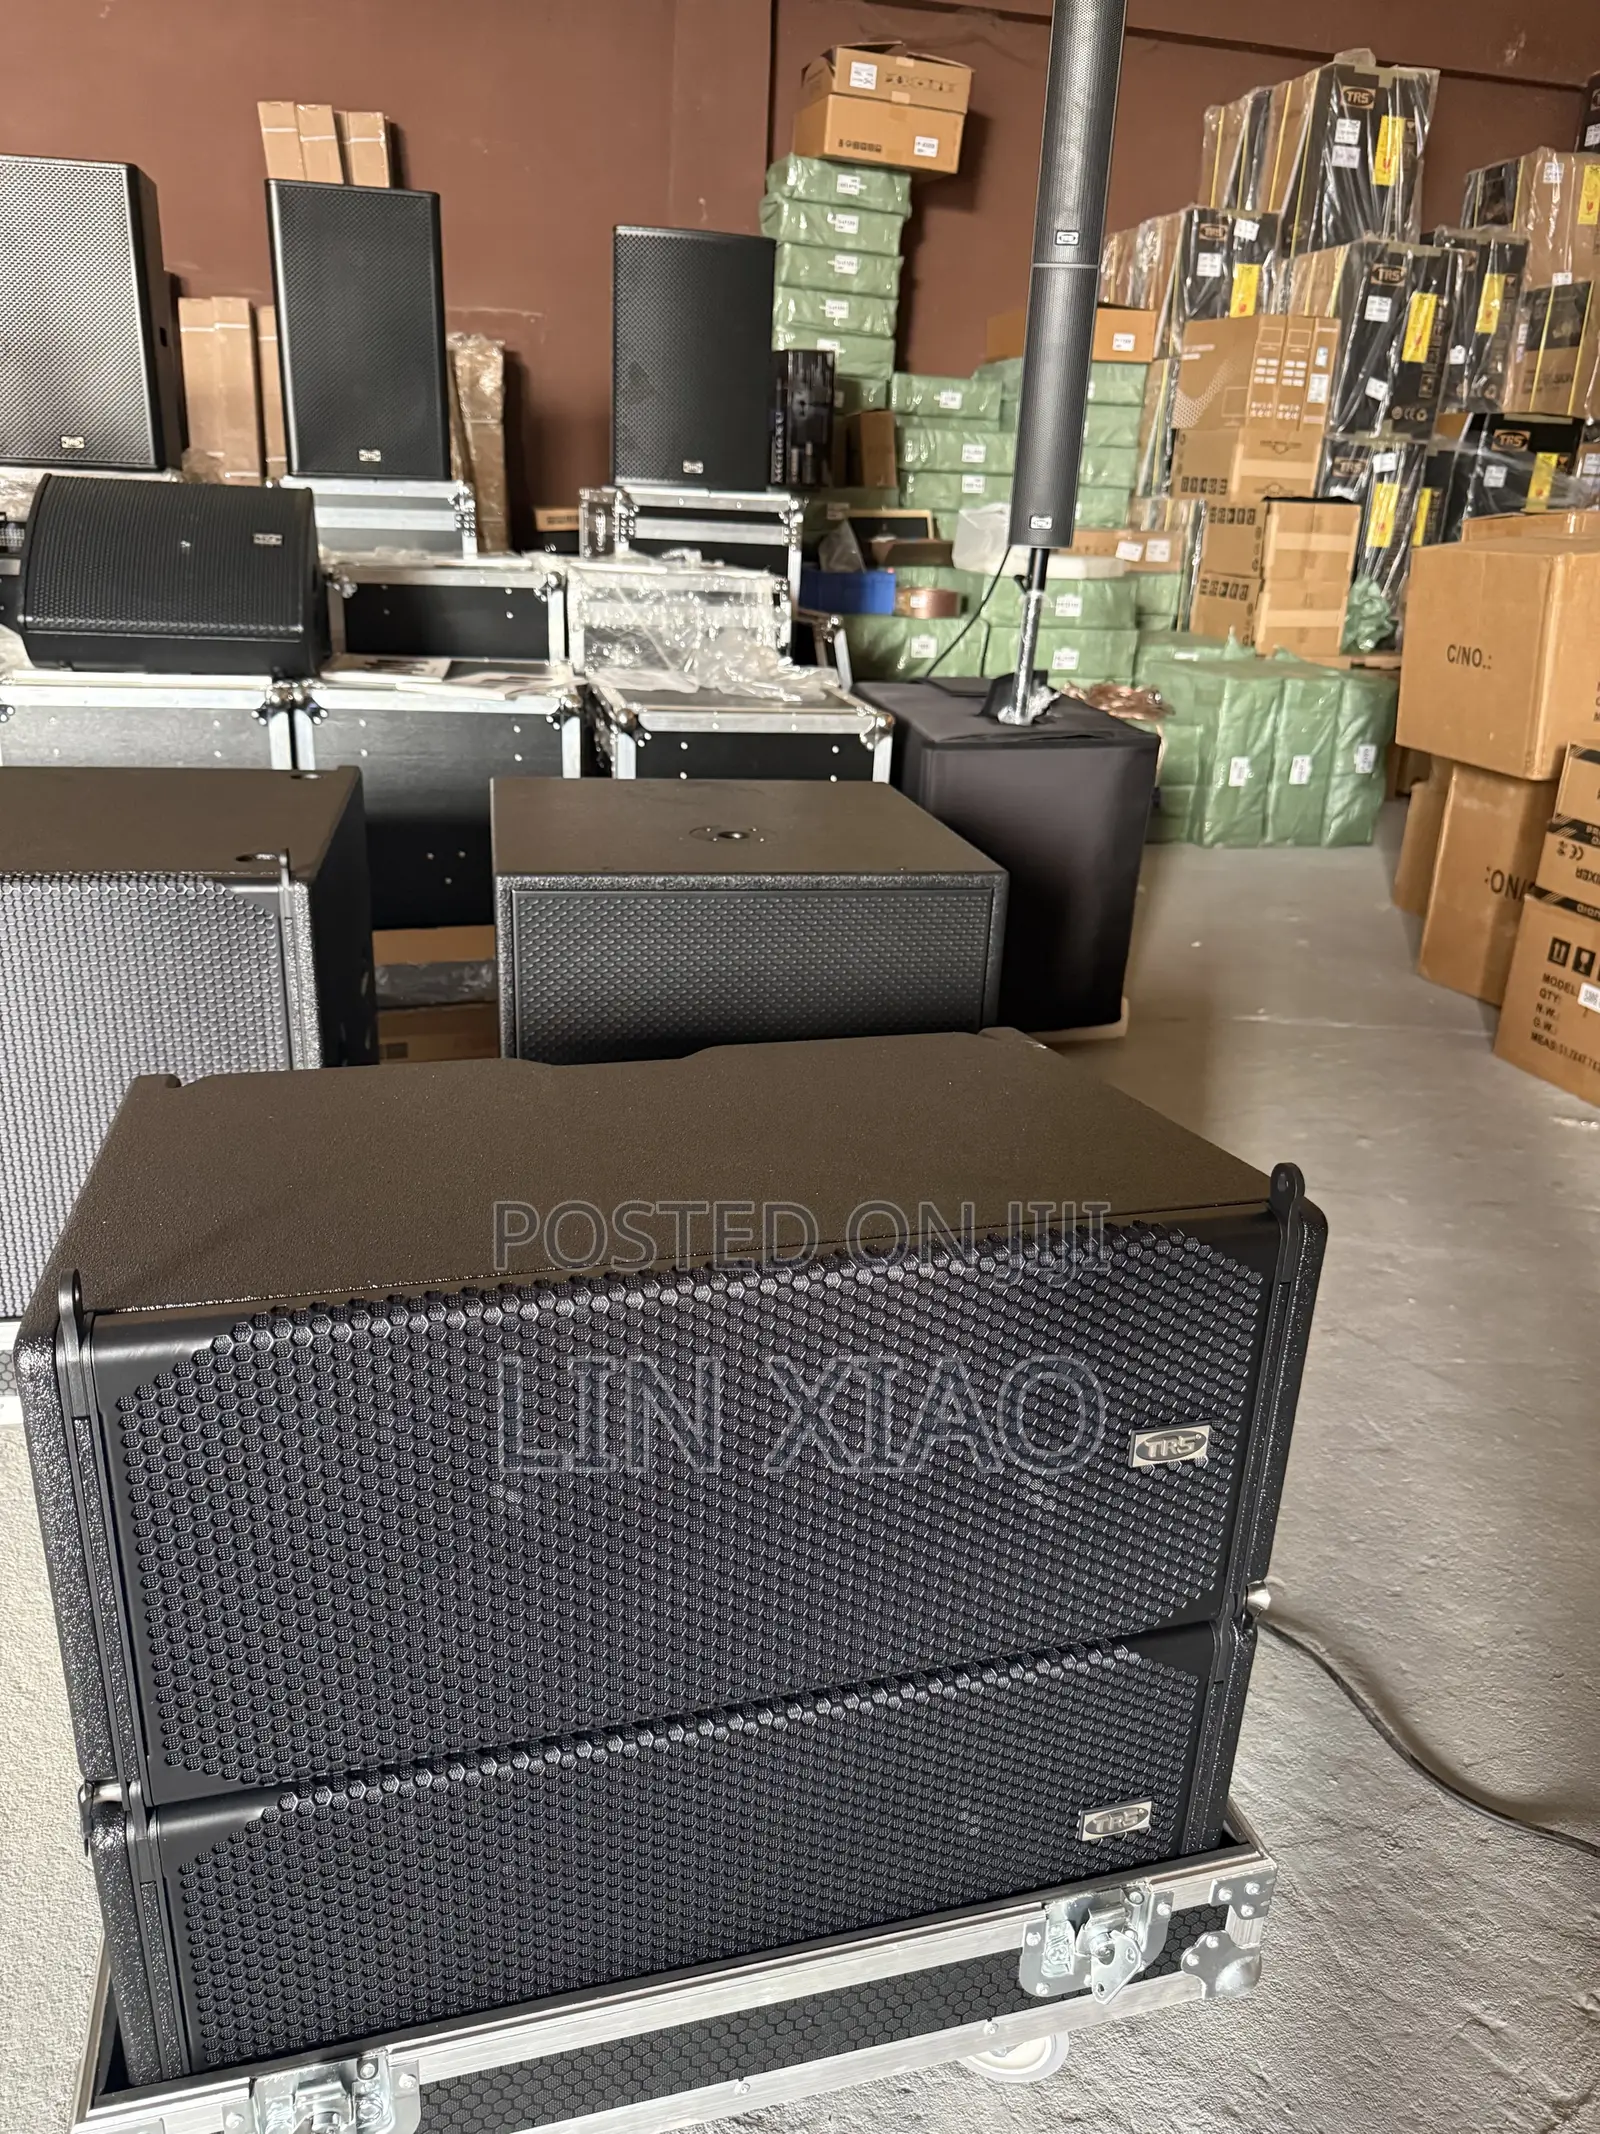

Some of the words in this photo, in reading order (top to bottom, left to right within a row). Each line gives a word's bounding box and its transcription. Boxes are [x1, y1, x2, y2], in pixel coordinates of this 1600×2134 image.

[1346, 91, 1369, 104] TRS
[1378, 268, 1401, 281] TRS
[1500, 434, 1523, 447] TRS
[1144, 1434, 1202, 1458] TRS
[1092, 1807, 1145, 1833] TRS
